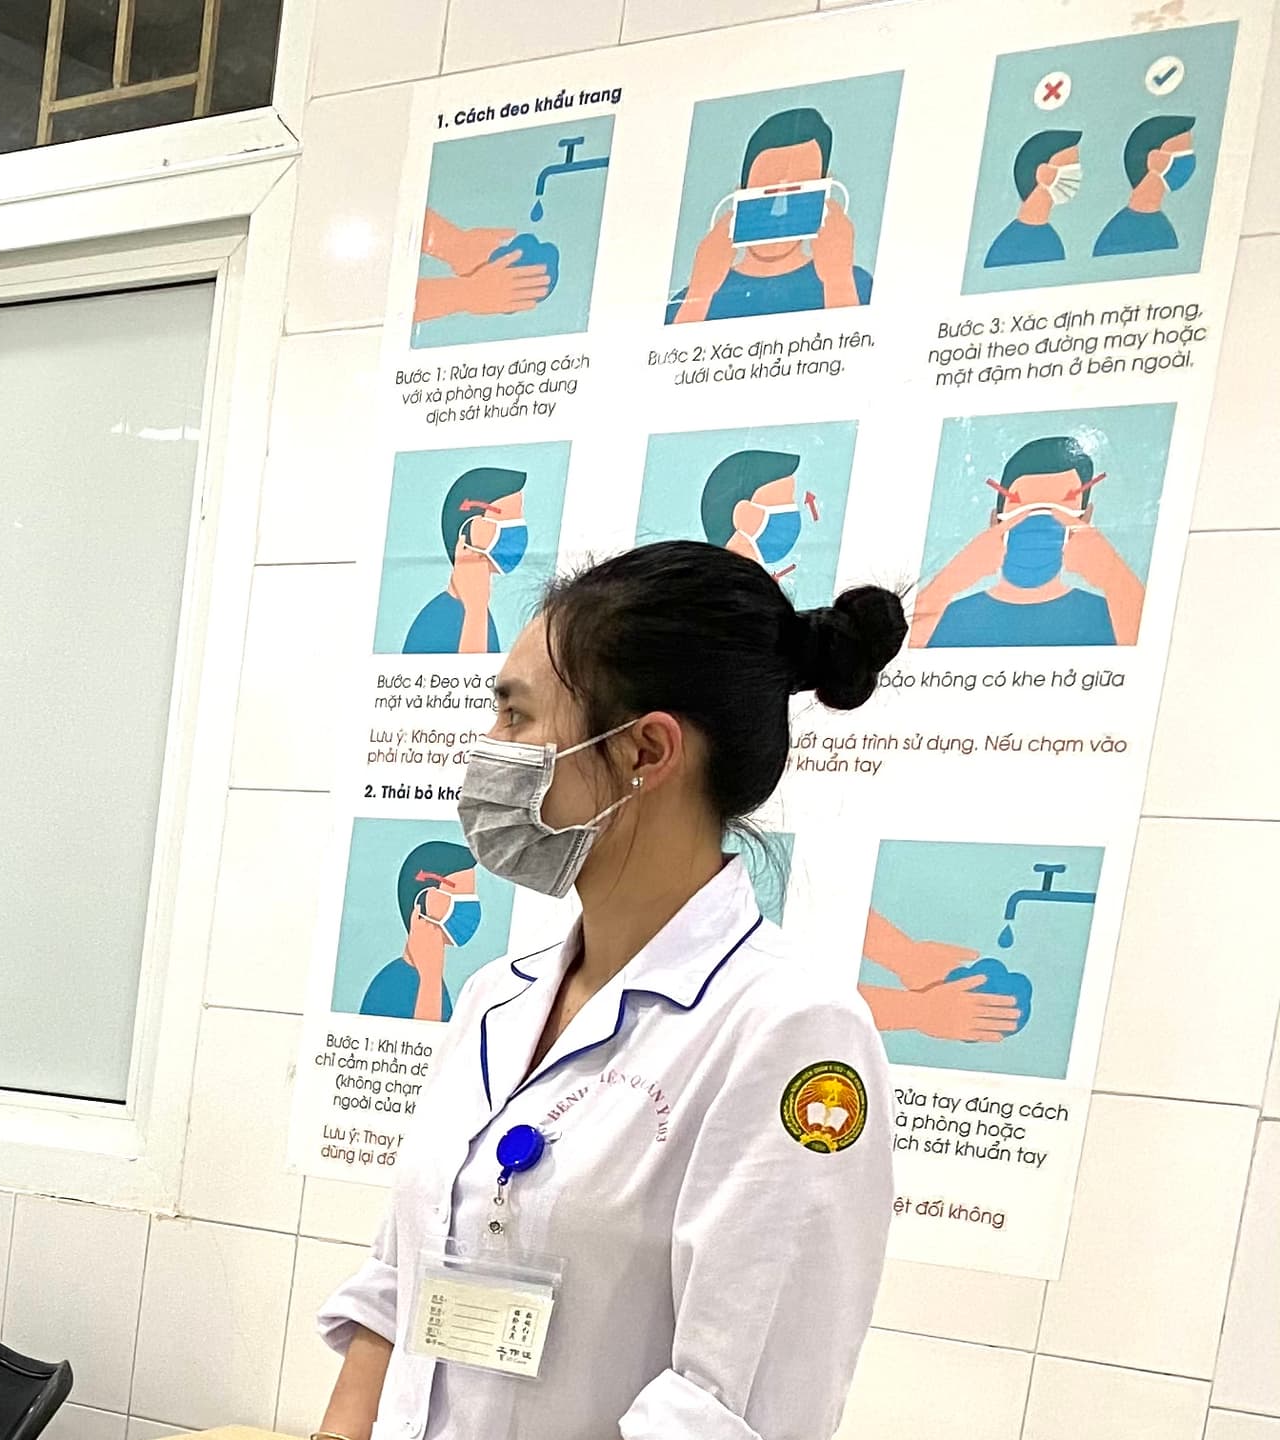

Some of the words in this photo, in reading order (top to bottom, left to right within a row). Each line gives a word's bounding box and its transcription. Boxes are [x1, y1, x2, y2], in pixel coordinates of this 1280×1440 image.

[437, 115, 448, 128] 1.
[454, 106, 495, 125] Cách
[500, 102, 530, 118] đeo
[534, 89, 574, 113] khẩu
[579, 87, 622, 104] trang
[938, 319, 985, 339] Bước
[990, 317, 1005, 334] 3:
[1010, 314, 1048, 332] Xác
[1053, 310, 1095, 331] định
[1100, 306, 1140, 326] mặt
[1146, 303, 1202, 321] trong,
[648, 348, 688, 366] Bước
[692, 347, 705, 361] 2:
[710, 343, 743, 360] Xác
[747, 339, 783, 357] định
[787, 332, 833, 356] phần
[928, 343, 982, 366] ngoài
[987, 340, 1029, 359] theo
[1035, 335, 1098, 355] đường
[1104, 330, 1148, 350] may
[1153, 325, 1207, 347] hoặc
[396, 368, 431, 385] Bước
[437, 367, 446, 382] 1:
[450, 363, 478, 380] Rửa
[482, 364, 504, 379] tay
[508, 358, 546, 376] đúng
[550, 354, 590, 371] cách
[674, 367, 709, 385] dưới
[713, 363, 746, 382] của
[750, 357, 791, 379] khẩu
[936, 367, 972, 388] mặt
[978, 364, 1021, 385] đậm
[1027, 361, 1063, 378] hơn
[1069, 357, 1083, 376] ở
[1088, 356, 1126, 374] bên
[402, 389, 422, 404] với
[425, 388, 442, 403] xà
[445, 385, 492, 404] phòng
[496, 381, 534, 400] hoặc
[538, 378, 577, 395] dung
[426, 407, 456, 426] dịch
[459, 405, 481, 420] sát
[484, 400, 528, 419] khuẩn
[532, 401, 556, 417] tay
[377, 674, 411, 689] Bước
[415, 674, 426, 689] 4:
[430, 674, 460, 689] Đeo
[464, 674, 481, 689] và
[920, 670, 977, 691] không
[982, 670, 1007, 687] có
[1012, 671, 1046, 687] khe
[1051, 668, 1077, 687] hở
[1081, 670, 1125, 691] giữa
[374, 694, 402, 711] mặt
[406, 695, 422, 708] và
[426, 691, 460, 709] khẩu
[370, 728, 393, 743] Lưu
[397, 729, 407, 746] ý:
[411, 730, 455, 747] Không
[790, 731, 818, 749] uốt
[822, 733, 856, 752] quá
[862, 733, 898, 750] trình
[903, 733, 923, 750] sử
[927, 735, 978, 755] dụng.
[985, 733, 1022, 751] Nếu
[1028, 736, 1084, 755] chạm
[1090, 736, 1128, 753] vào
[367, 748, 398, 765] phải
[401, 748, 423, 764] rửa
[427, 750, 449, 767] tay
[797, 752, 849, 772] khuẩn
[854, 757, 881, 776] tay
[364, 785, 376, 798] 2.
[382, 783, 410, 799] Thải
[414, 784, 433, 800] bỏ
[326, 1034, 360, 1050] Bước
[378, 1039, 398, 1054] Khi
[401, 1041, 432, 1057] tháo
[315, 1052, 336, 1067] chỉ
[338, 1053, 368, 1070] cầm
[371, 1057, 407, 1075] phần
[336, 1074, 381, 1094] (không
[333, 1095, 372, 1110] ngoài
[374, 1097, 401, 1113] của
[932, 1093, 961, 1113] tay
[965, 1096, 1014, 1118] đúng
[1018, 1102, 1069, 1121] cách
[323, 1125, 345, 1140] Lưu
[349, 1128, 360, 1144] ý:
[364, 1130, 395, 1149] Thay
[895, 1111, 908, 1127] à
[912, 1114, 971, 1137] phòng
[976, 1120, 1026, 1141] hoặc
[321, 1144, 355, 1163] dùng
[358, 1149, 374, 1165] lại
[893, 1134, 919, 1151] ịch
[923, 1138, 951, 1154] sát
[955, 1141, 1011, 1162] khuẩn
[1017, 1147, 1047, 1169] tay
[893, 1197, 912, 1216] ệt
[915, 1200, 944, 1218] đối
[948, 1203, 1005, 1229] không
